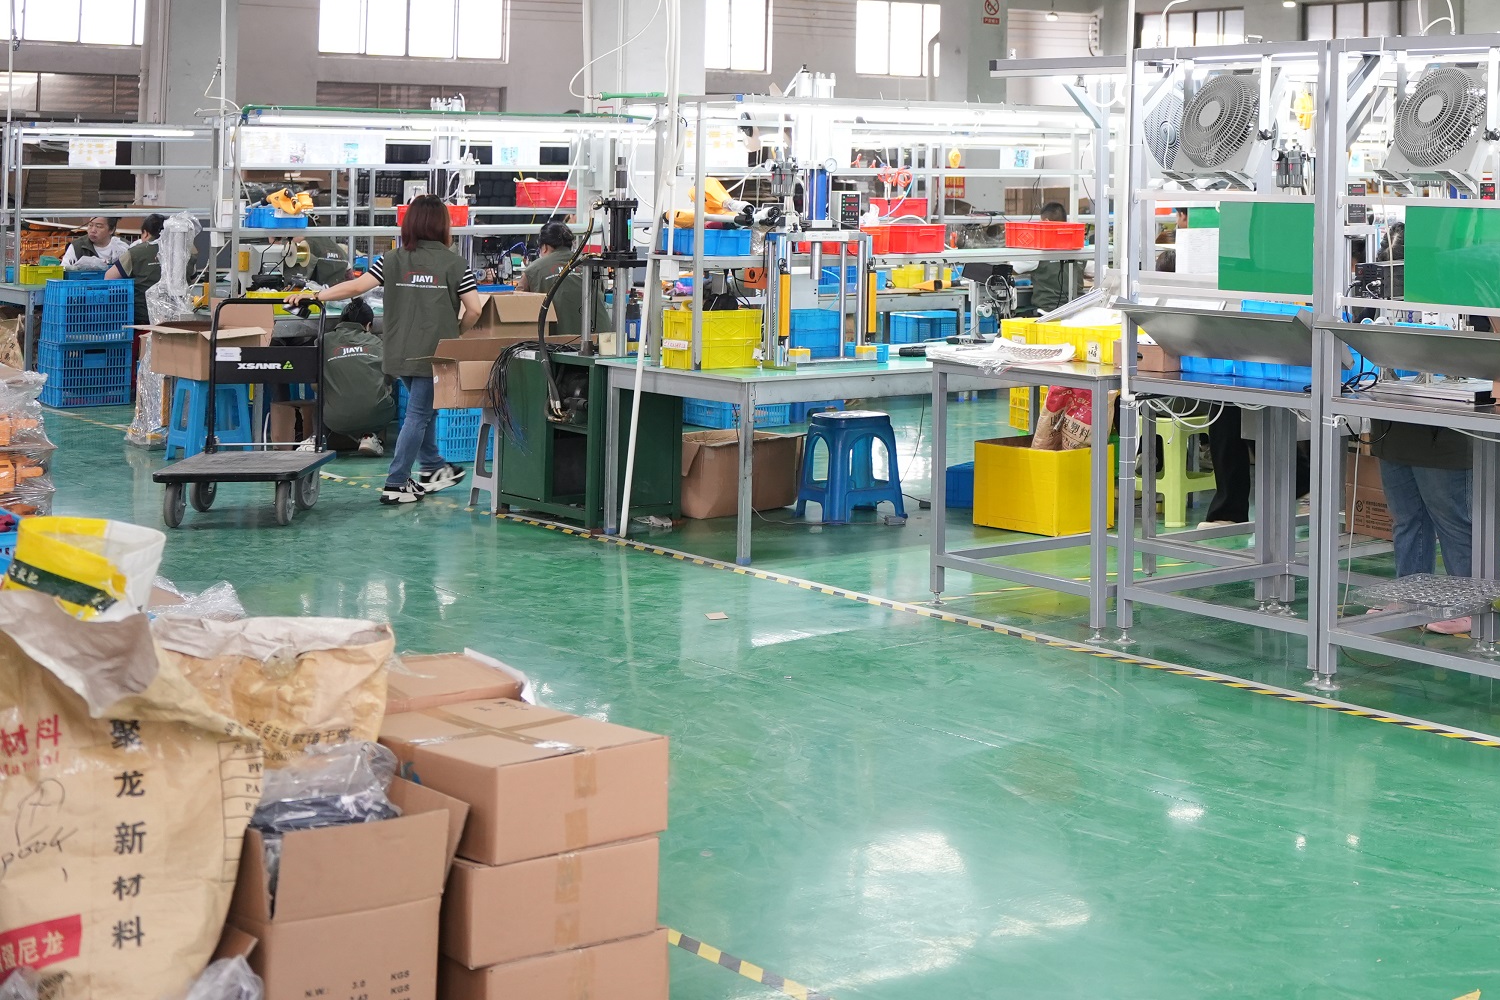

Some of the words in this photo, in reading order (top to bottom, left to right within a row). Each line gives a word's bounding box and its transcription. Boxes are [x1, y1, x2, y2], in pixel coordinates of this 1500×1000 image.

[411, 274, 434, 283] JIAYI
[342, 346, 363, 355] JIAYI
[110, 719, 147, 949] 聚龙新材料
[390, 970, 409, 981] KGS
[390, 984, 410, 995] KGS
